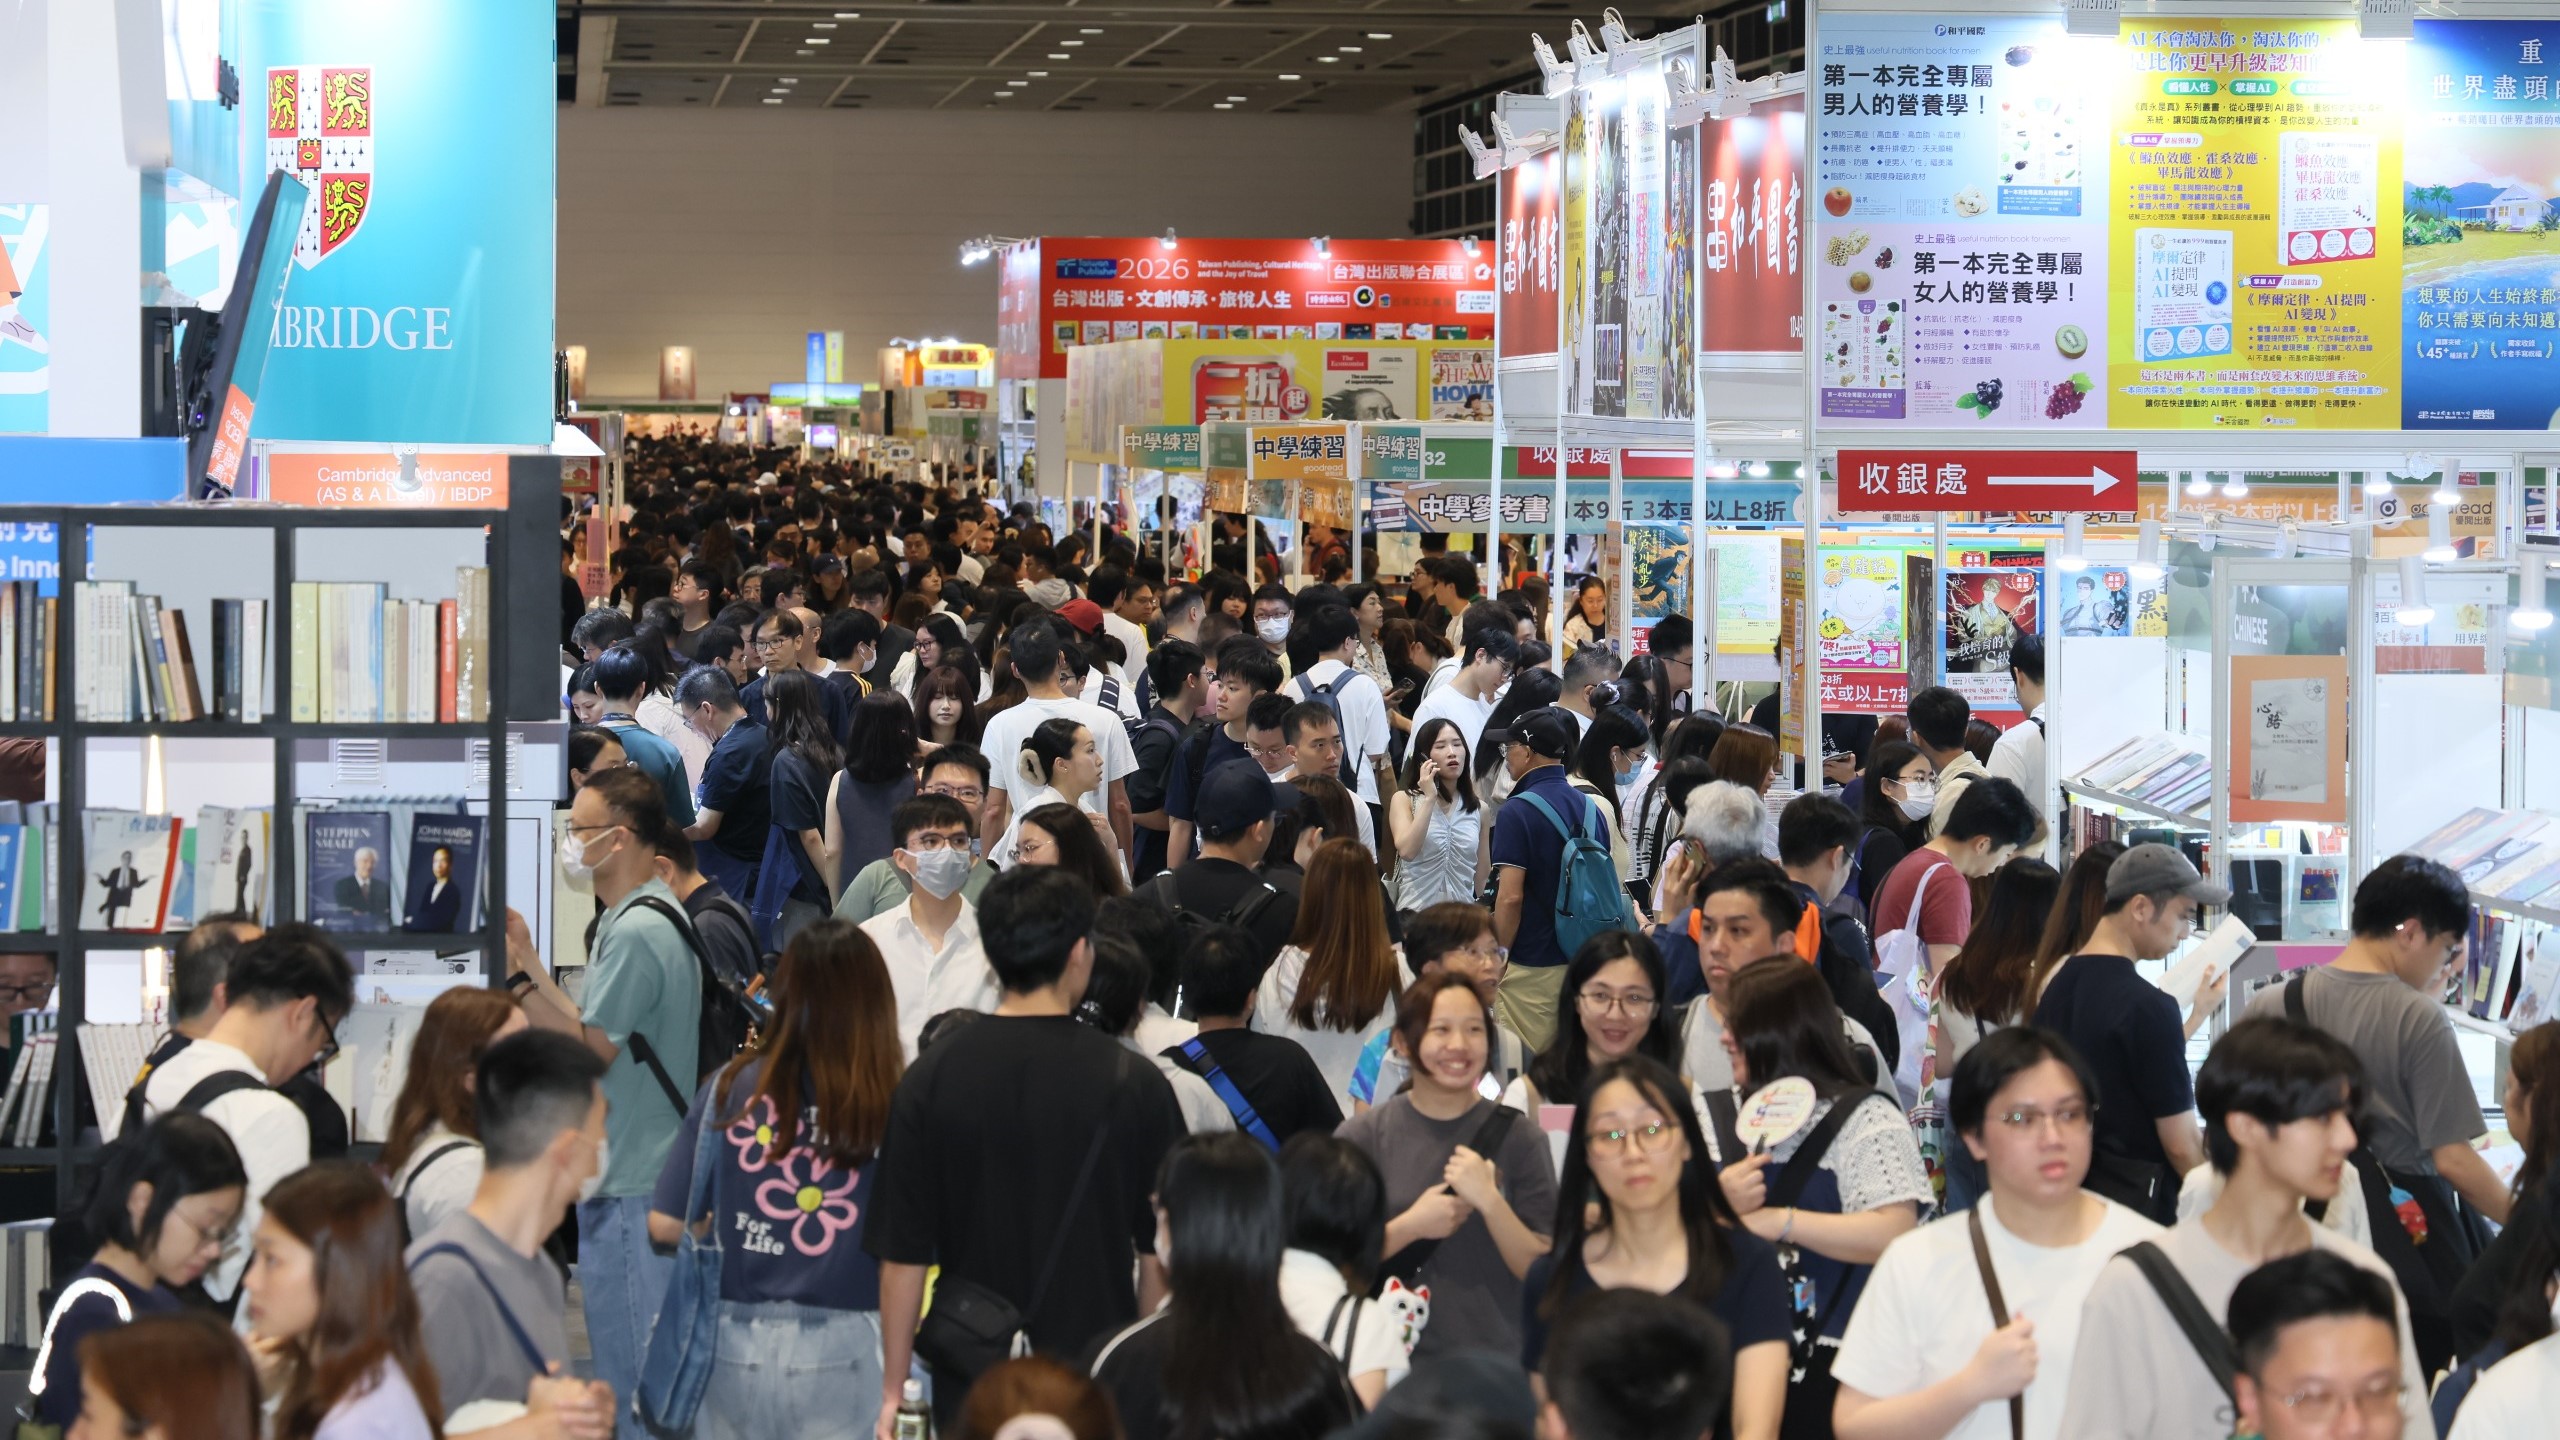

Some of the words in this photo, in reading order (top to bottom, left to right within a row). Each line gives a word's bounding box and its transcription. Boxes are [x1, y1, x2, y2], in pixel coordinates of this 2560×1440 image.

[2128, 32, 2146, 46] AI
[1824, 45, 1865, 56] 史上最強
[1866, 46, 1889, 54] useful
[1891, 46, 1924, 54] nutrition
[1926, 46, 1947, 54] book
[1950, 46, 1960, 54] for
[2518, 38, 2544, 64] 重
[1823, 64, 1993, 88] 第一本完全專屬
[1823, 94, 1985, 116] 男人的營養學！
[2275, 103, 2284, 112] AI
[2295, 187, 2350, 202] 霍桑效應
[1730, 171, 1802, 279] 和平圖書
[1914, 234, 1956, 244] 史上最強
[1958, 235, 1978, 243] useful
[1518, 211, 1558, 298] 和平圖書
[1914, 252, 2083, 276] 第一本完全專屬
[2152, 250, 2206, 265] 摩爾定律
[1119, 258, 1190, 280] 2026
[1198, 260, 1222, 268] Taiwan
[1223, 260, 1262, 270] Publishing,
[1263, 260, 1290, 269] Cultural
[1198, 270, 1212, 278] and
[1212, 270, 1224, 278] the
[1224, 270, 1237, 278] Joy
[1238, 270, 1246, 278] of
[1247, 270, 1268, 278] Travel
[1334, 264, 1464, 280] 台灣出版聯合展區
[2152, 268, 2169, 282] AI
[2172, 266, 2198, 281] 提問
[1914, 280, 2075, 304] 女人的營養學！
[2152, 284, 2169, 298] AI
[2172, 283, 2198, 297] 變現
[2324, 294, 2338, 306] AI
[2284, 308, 2298, 320] AI
[1286, 390, 1306, 410] 起
[2210, 400, 2220, 408] AI
[1124, 432, 1200, 453] 中學練習
[1254, 435, 1346, 460] 中學練習
[1362, 434, 1421, 461] 中學練習
[1303, 464, 1344, 474] goodread
[1858, 462, 1968, 495] 收銀處
[317, 486, 346, 505] (AS
[352, 488, 364, 502] &
[369, 488, 382, 502] A
[450, 488, 492, 502] IBDP
[1418, 494, 1550, 524] 中學參考書
[2456, 516, 2492, 525] 優閱出版
[2234, 614, 2268, 646] CHINESE
[1959, 636, 2004, 657] 我培育的
[2256, 702, 2282, 730] 心路
[315, 827, 371, 838] STEPHEN
[418, 826, 442, 836] JOHN
[444, 826, 473, 838] MAEDA
[736, 1212, 772, 1236] For
[742, 1232, 786, 1256] Life
